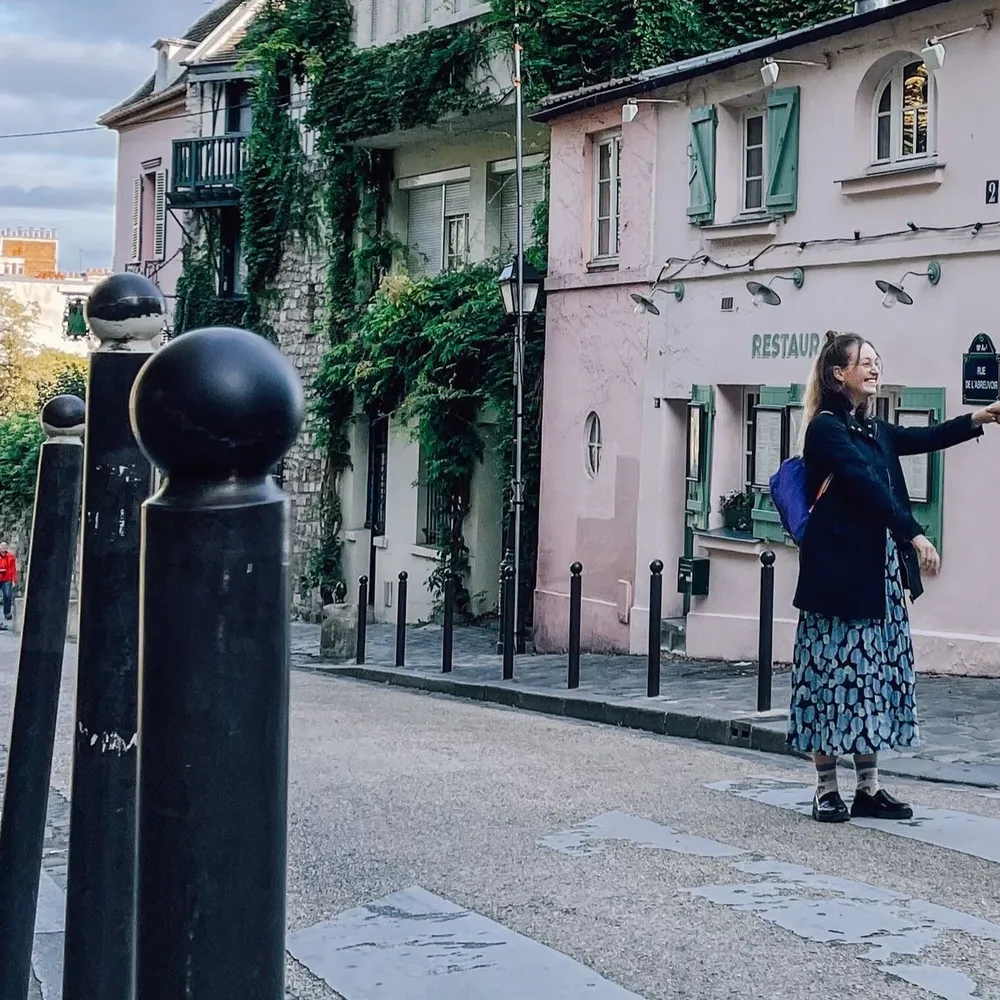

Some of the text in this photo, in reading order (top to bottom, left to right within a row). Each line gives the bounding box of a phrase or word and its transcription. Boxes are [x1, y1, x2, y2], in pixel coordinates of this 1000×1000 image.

[988, 181, 996, 203] 2
[751, 333, 820, 359] RESTAUR
[976, 366, 987, 376] RUE
